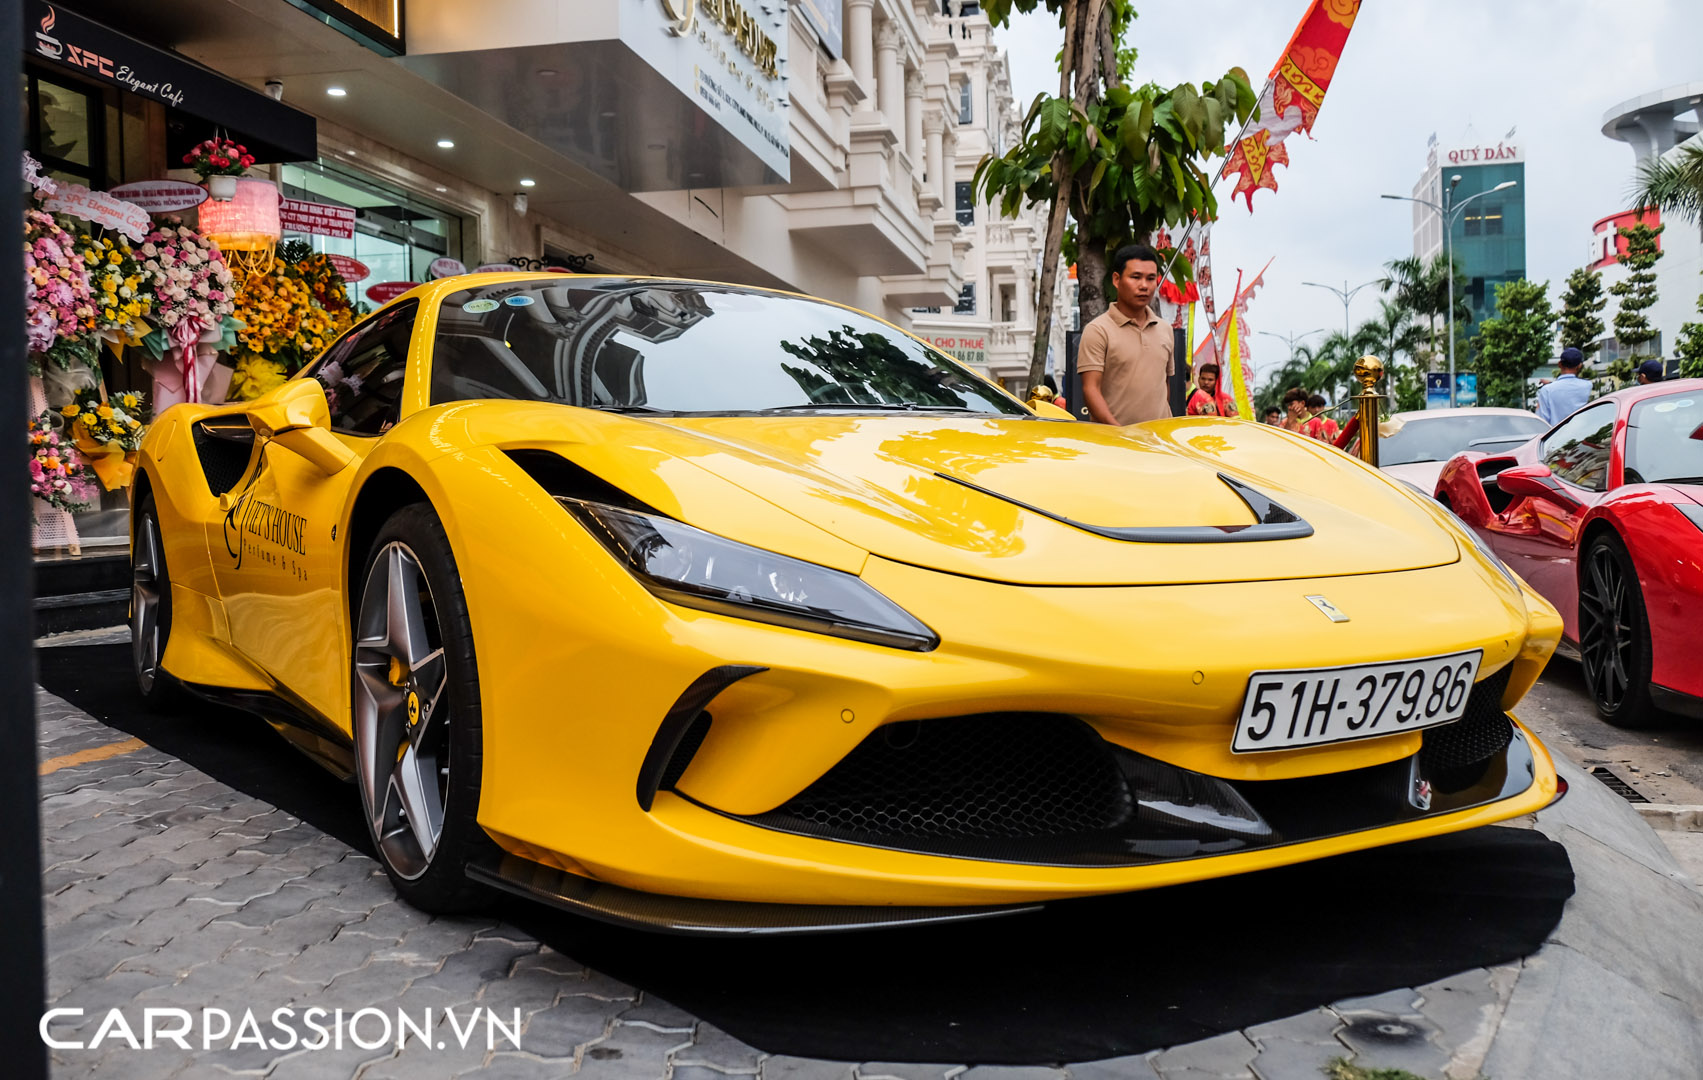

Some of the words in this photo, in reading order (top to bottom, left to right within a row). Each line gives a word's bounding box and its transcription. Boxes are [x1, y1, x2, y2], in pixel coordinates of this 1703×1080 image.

[66, 43, 114, 78] SPC
[115, 65, 159, 92] Elegant
[1448, 145, 1480, 164] QUÝ
[935, 338, 955, 348] CHO
[959, 337, 984, 349] THUÊ
[271, 507, 308, 556] HOUSE
[1247, 660, 1473, 742] 51H-379.86
